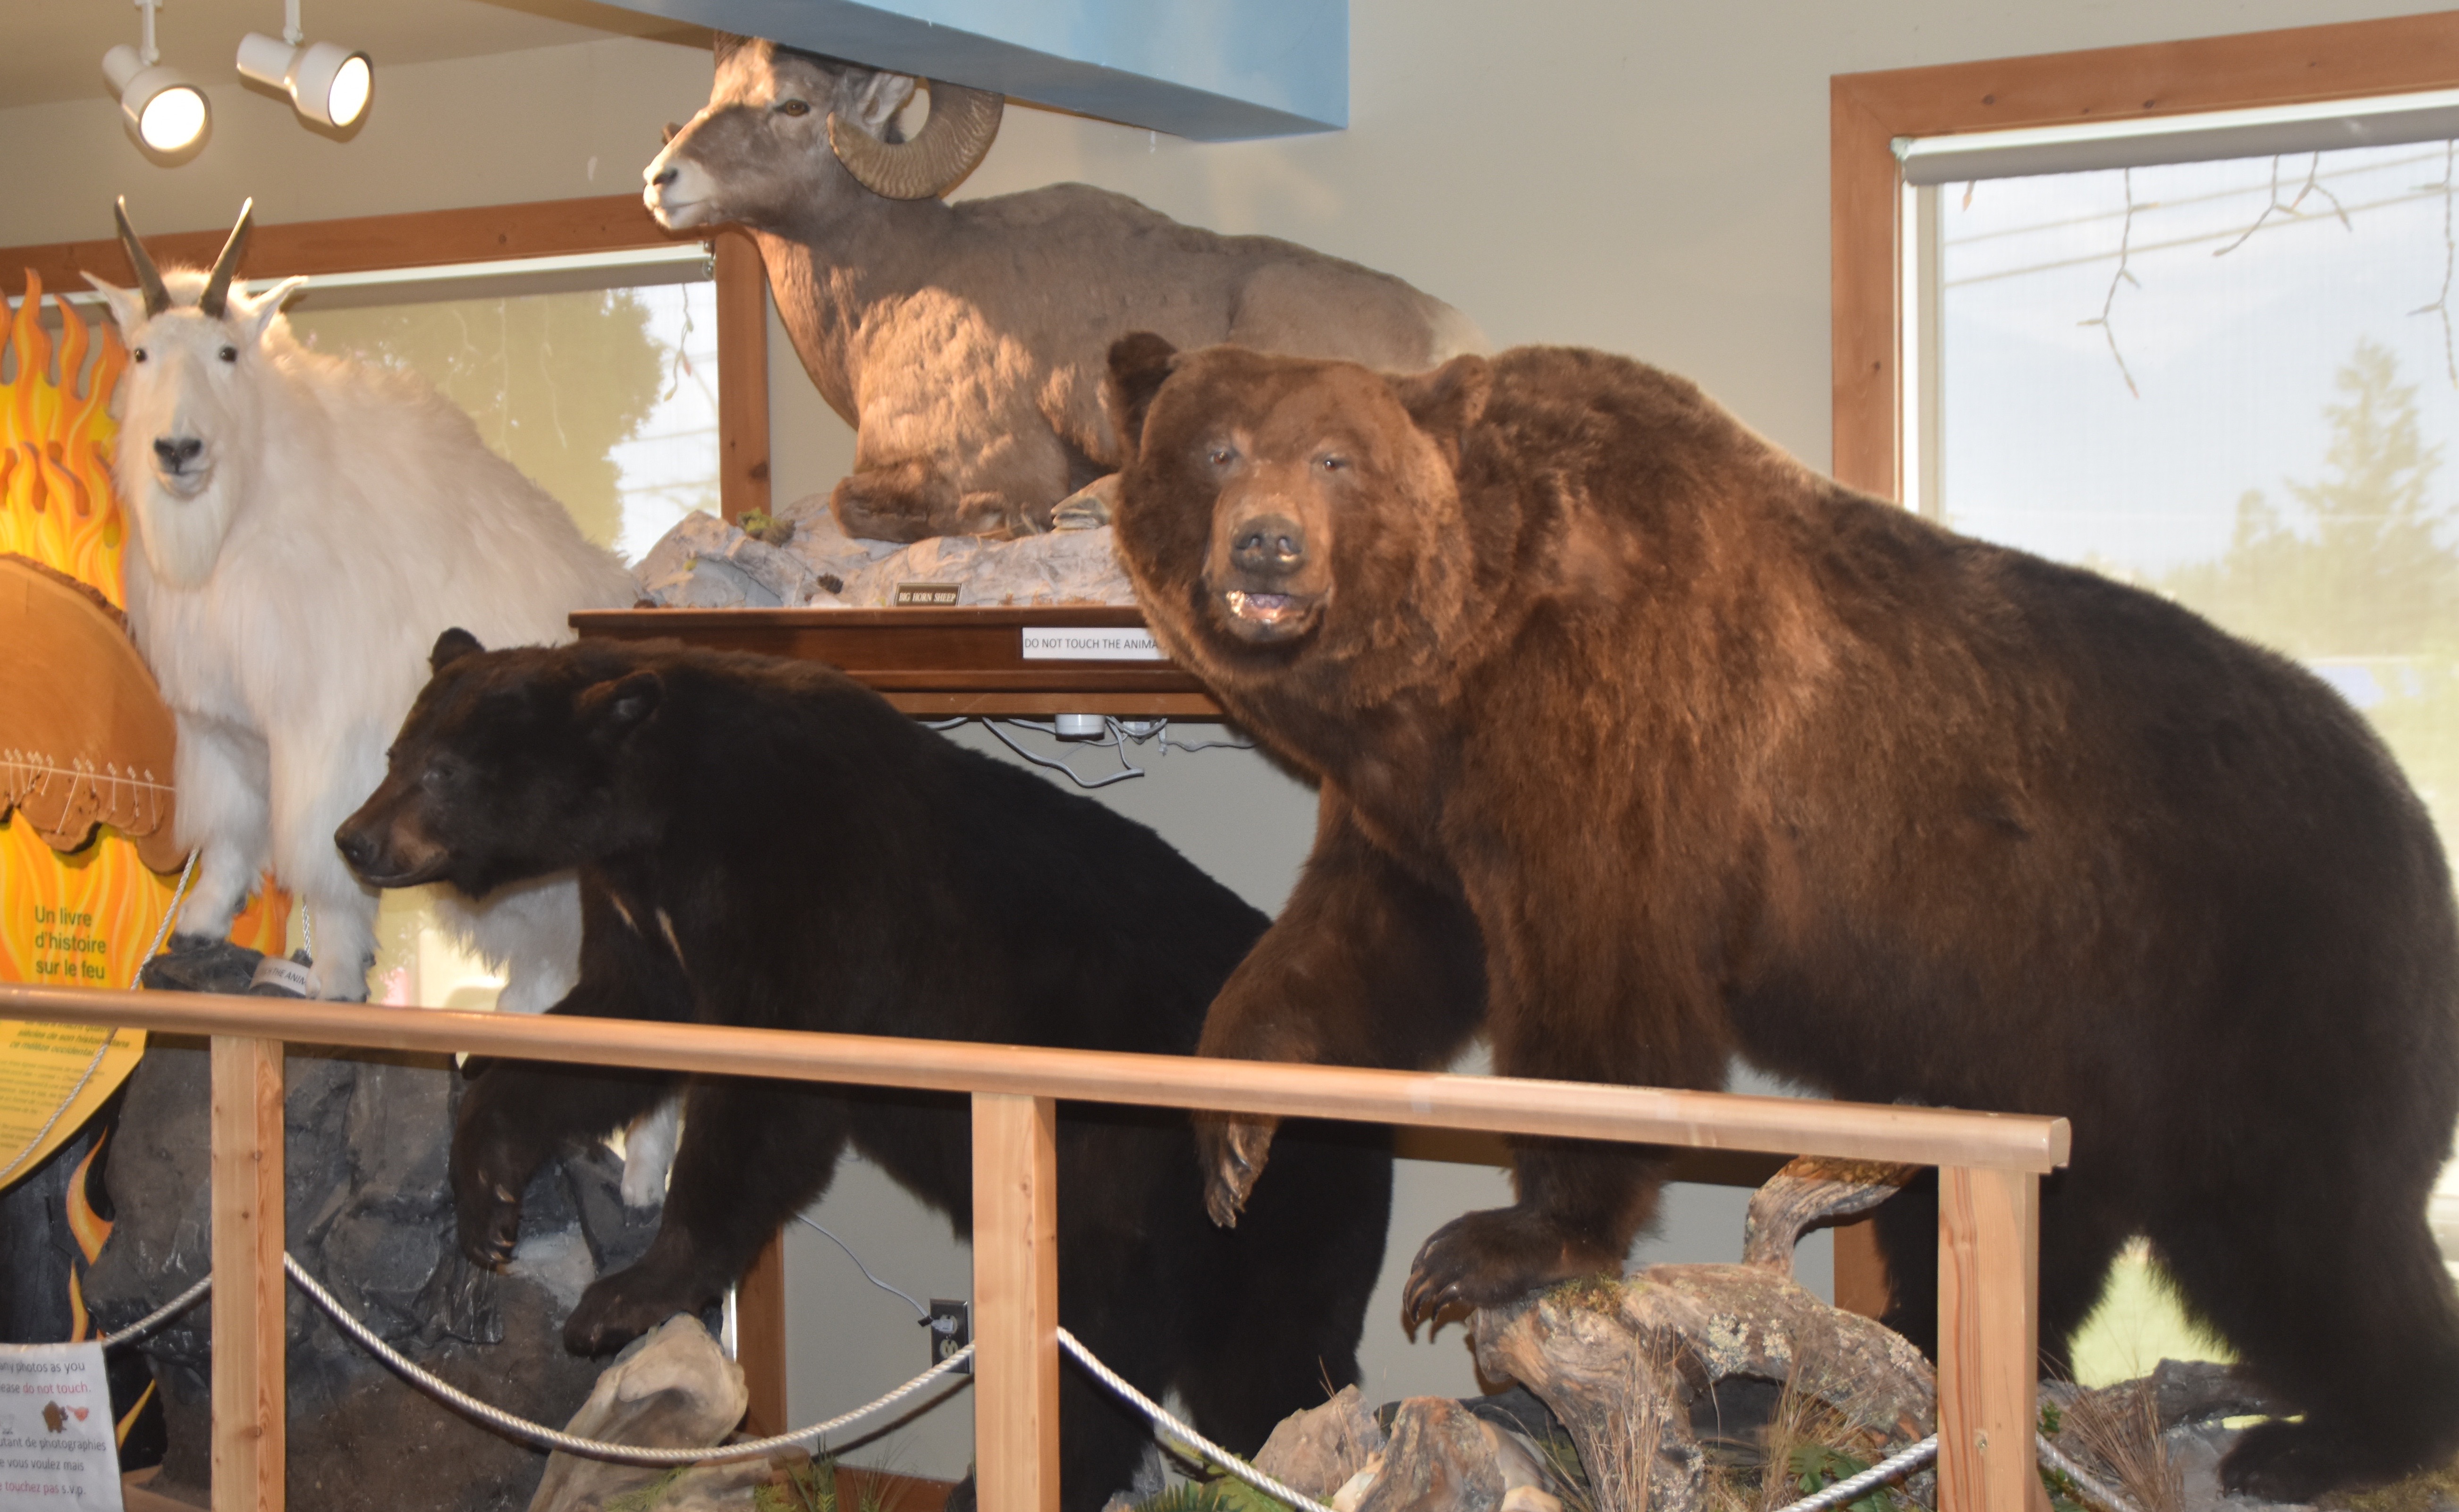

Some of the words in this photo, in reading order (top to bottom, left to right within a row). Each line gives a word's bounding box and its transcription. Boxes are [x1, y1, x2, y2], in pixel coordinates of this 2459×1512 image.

[899, 592, 911, 601] BIG
[912, 592, 932, 601] HORN
[934, 593, 956, 602] SHEEP
[1024, 638, 1039, 648] DO
[1042, 638, 1062, 648] NOT
[1065, 639, 1099, 648] TOUCH
[1102, 639, 1121, 649] THE
[1124, 639, 1159, 649] ANIMA
[35, 905, 55, 923] Un
[60, 907, 92, 927] livre
[35, 931, 106, 954] d'histoire
[36, 960, 59, 974] sur
[65, 959, 77, 977] le
[82, 960, 105, 979] feu
[284, 971, 306, 985] ANIM
[0, 1362, 14, 1374] any
[16, 1360, 47, 1373] photos
[51, 1363, 61, 1372] as
[65, 1362, 85, 1374] you
[0, 1383, 20, 1393] ease
[23, 1382, 34, 1393] do
[37, 1384, 53, 1393] not
[57, 1381, 91, 1393] touch.
[25, 1436, 37, 1448] de
[40, 1437, 106, 1452] photographies
[7, 1459, 28, 1469] vous
[31, 1459, 60, 1470] voulez
[63, 1461, 84, 1471] mais
[5, 1481, 41, 1493] touchez
[43, 1484, 59, 1495] pas
